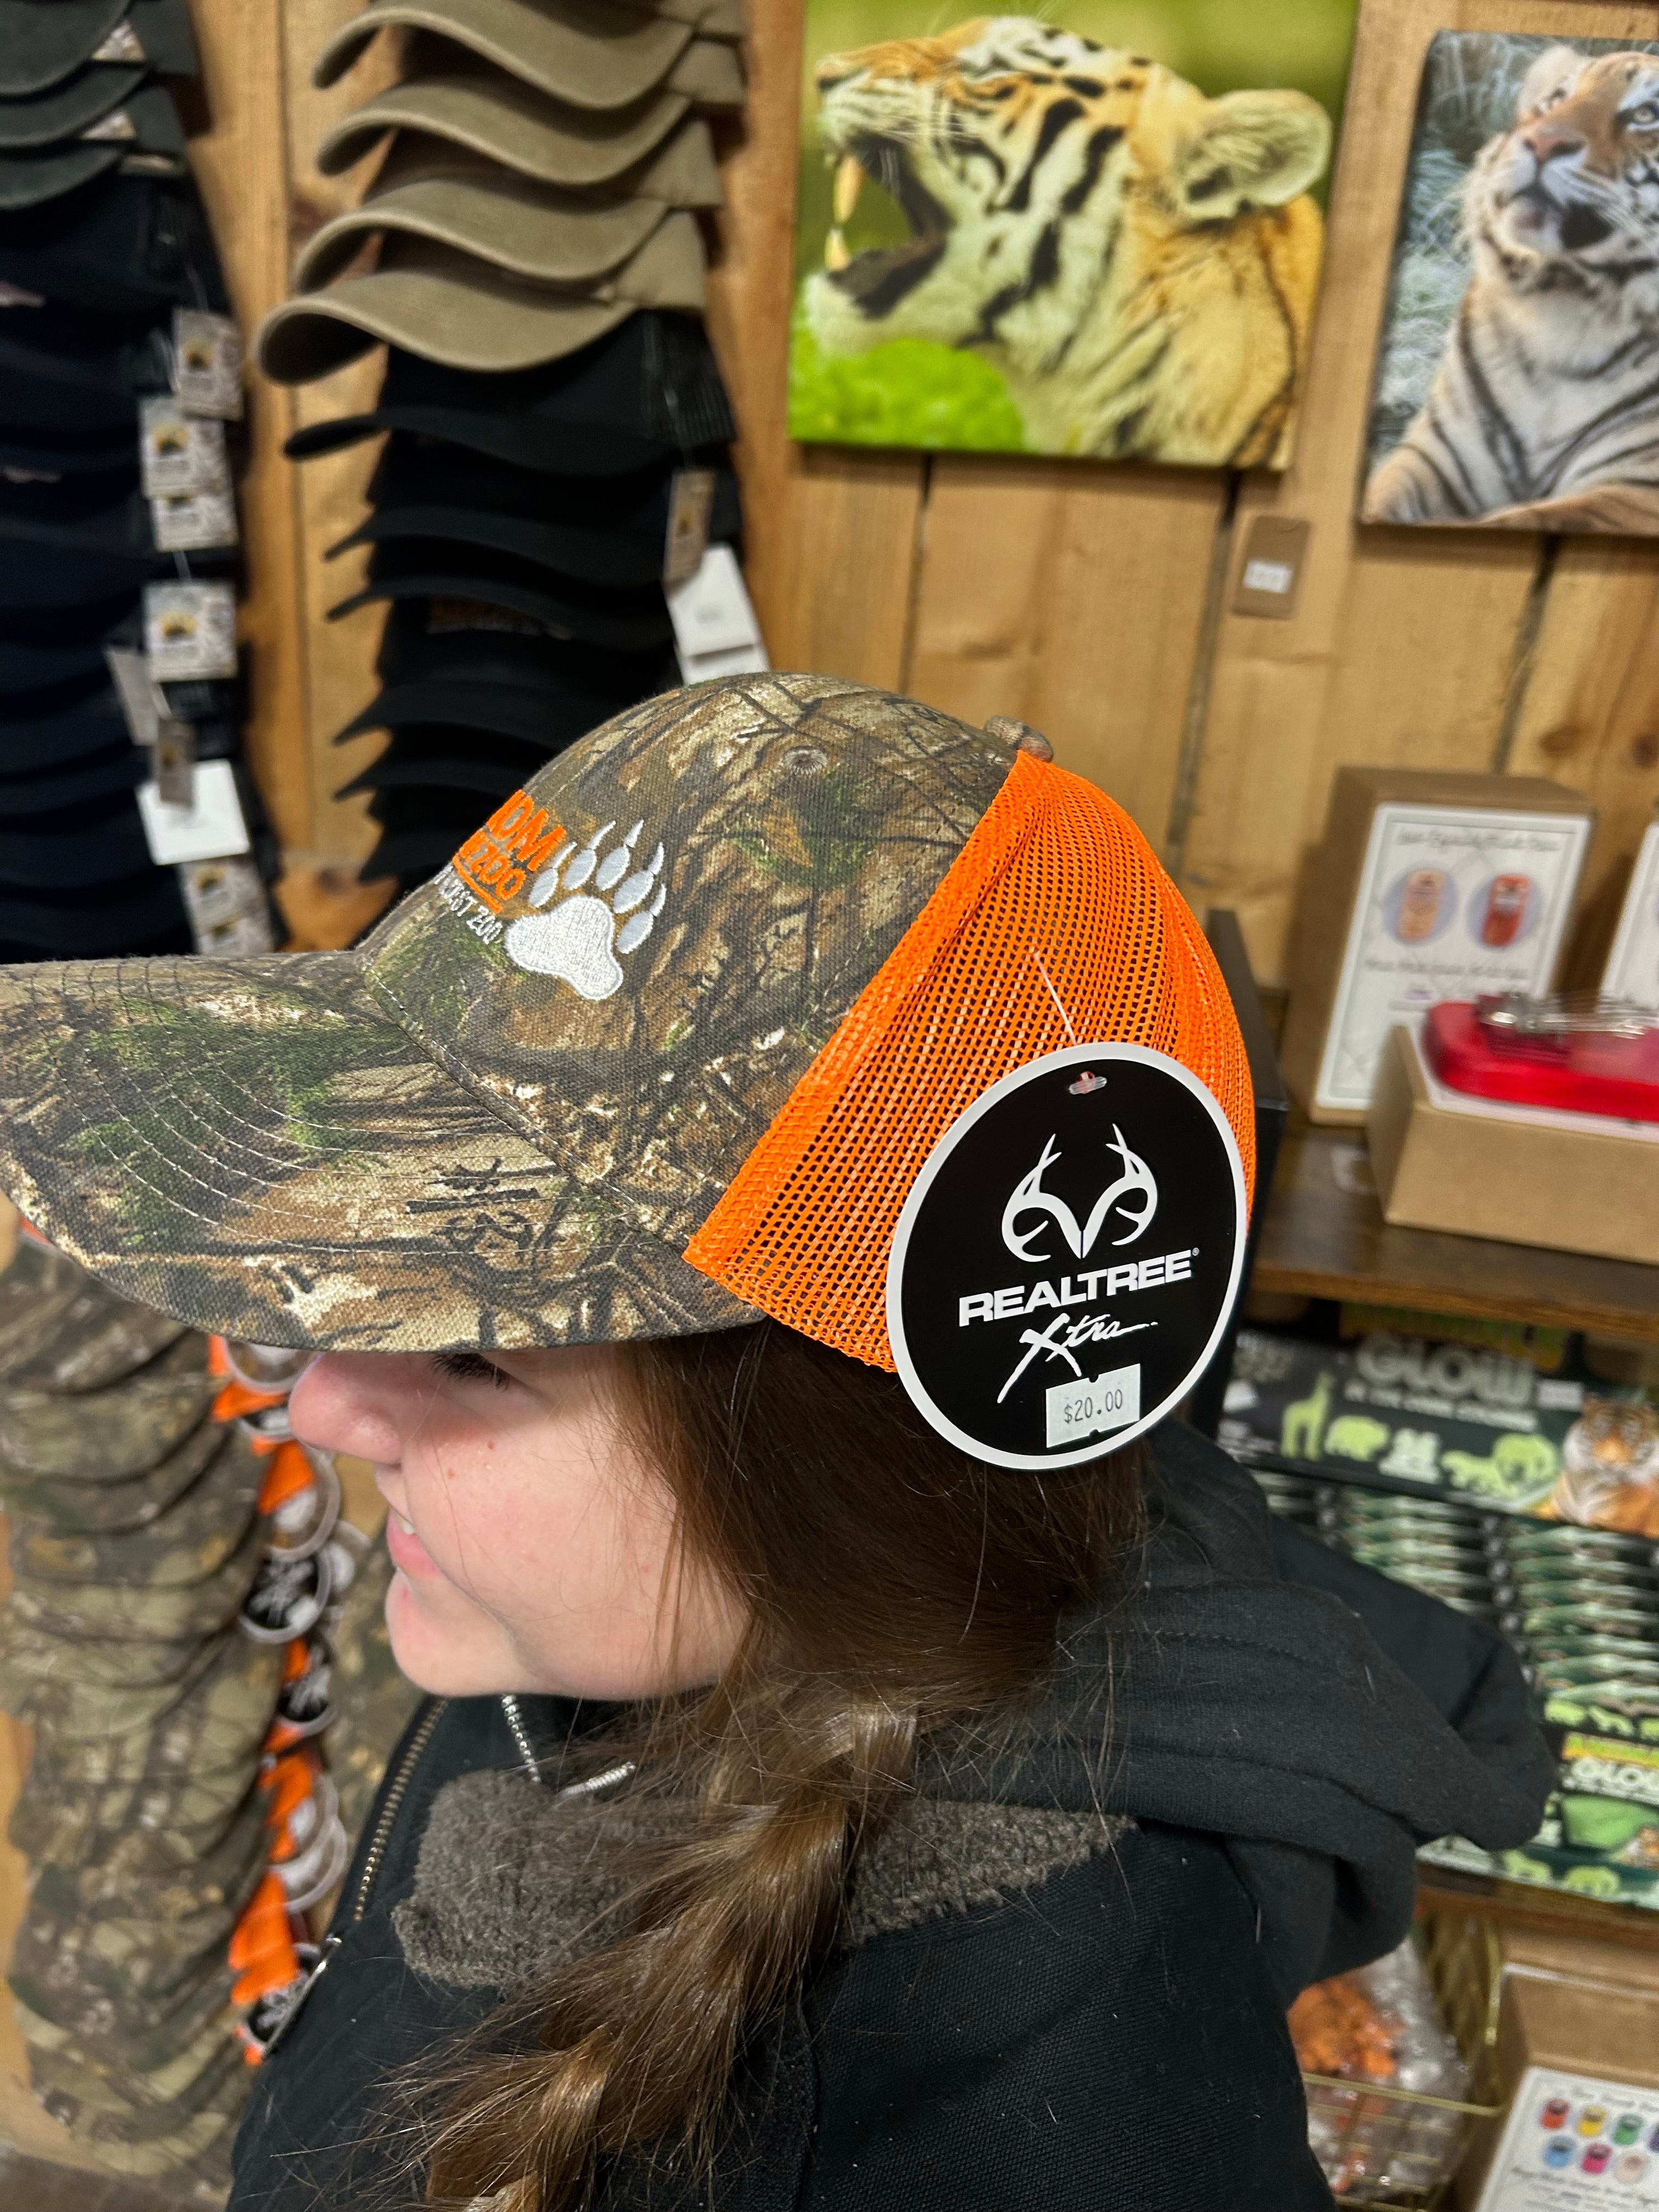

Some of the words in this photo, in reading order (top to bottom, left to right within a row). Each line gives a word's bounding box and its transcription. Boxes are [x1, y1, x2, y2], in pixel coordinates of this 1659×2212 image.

[487, 789, 567, 872] OM
[470, 842, 527, 900] ZOO
[959, 1249, 1192, 1327] REALTREE
[997, 1312, 1159, 1403] Xtra
[1357, 1333, 1534, 1409] GLOW
[1064, 1389, 1123, 1424] $20.00
